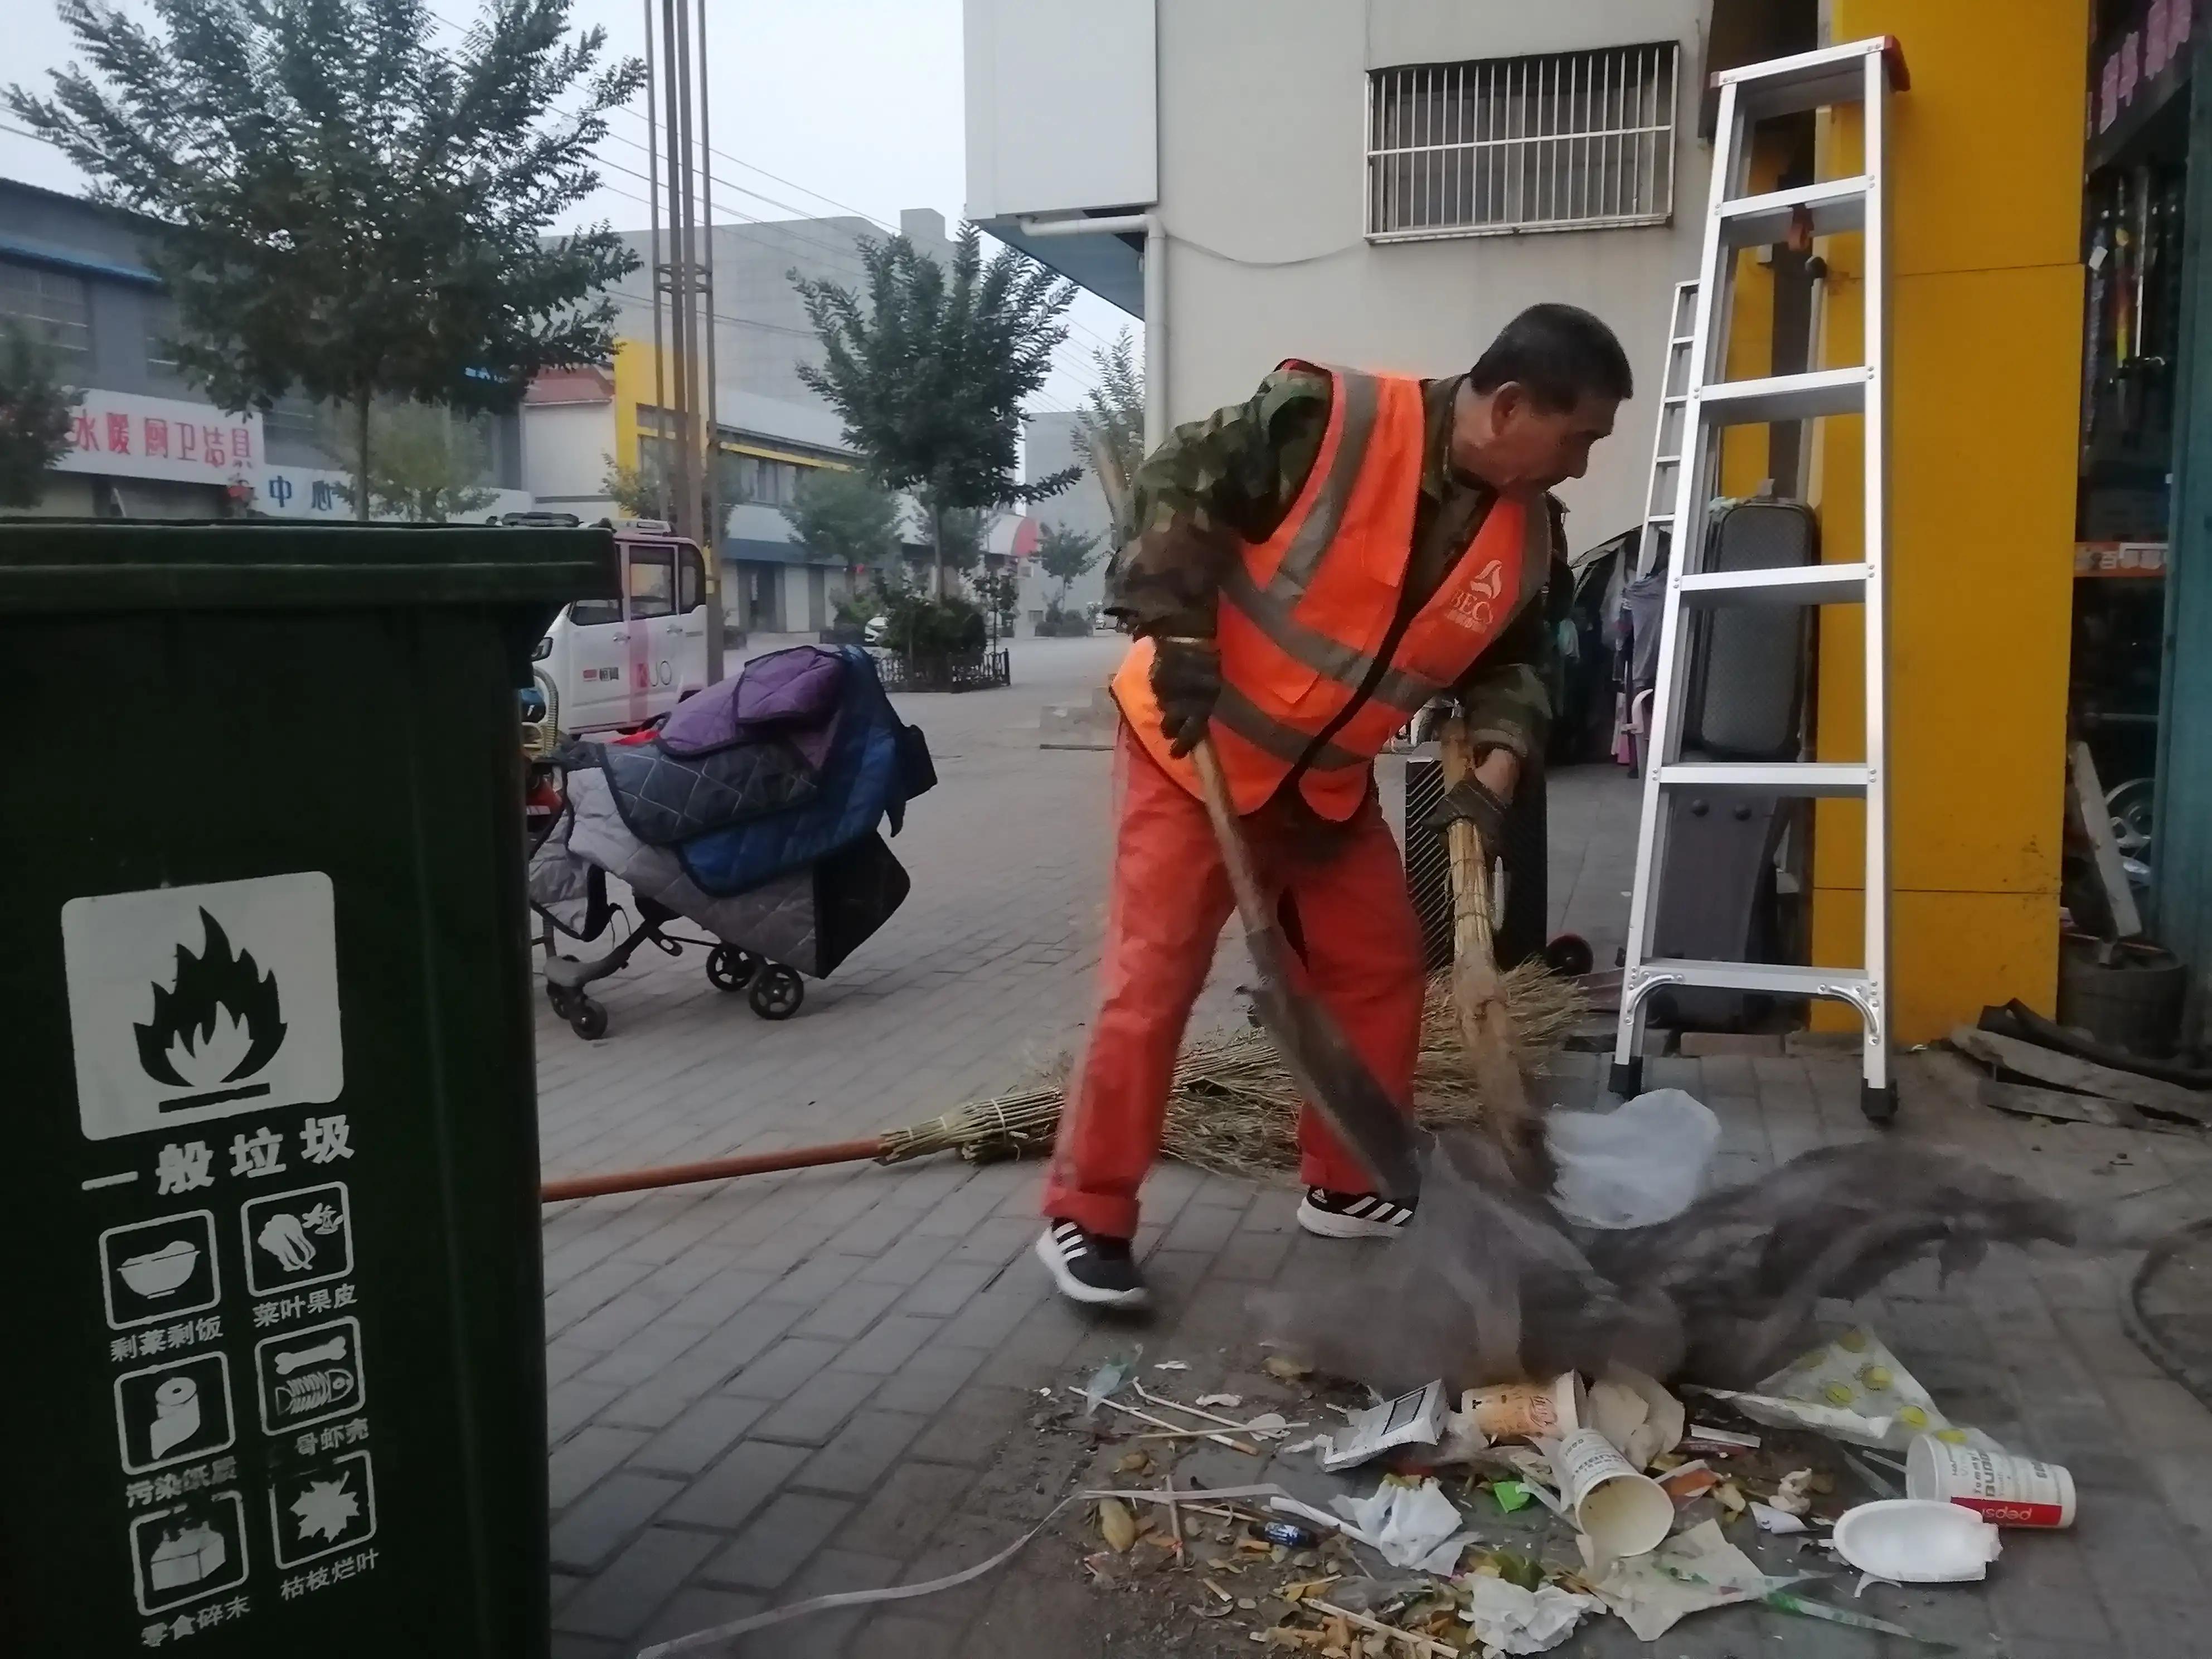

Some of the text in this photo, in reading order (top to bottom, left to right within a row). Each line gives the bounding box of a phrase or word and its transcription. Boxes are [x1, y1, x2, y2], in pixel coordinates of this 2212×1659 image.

[81, 1114, 355, 1195] 一般垃圾
[253, 1283, 357, 1327] 菜叶果皮
[110, 1316, 223, 1361] 剩菜剩饭
[280, 1548, 379, 1600] 枯枝烂叶
